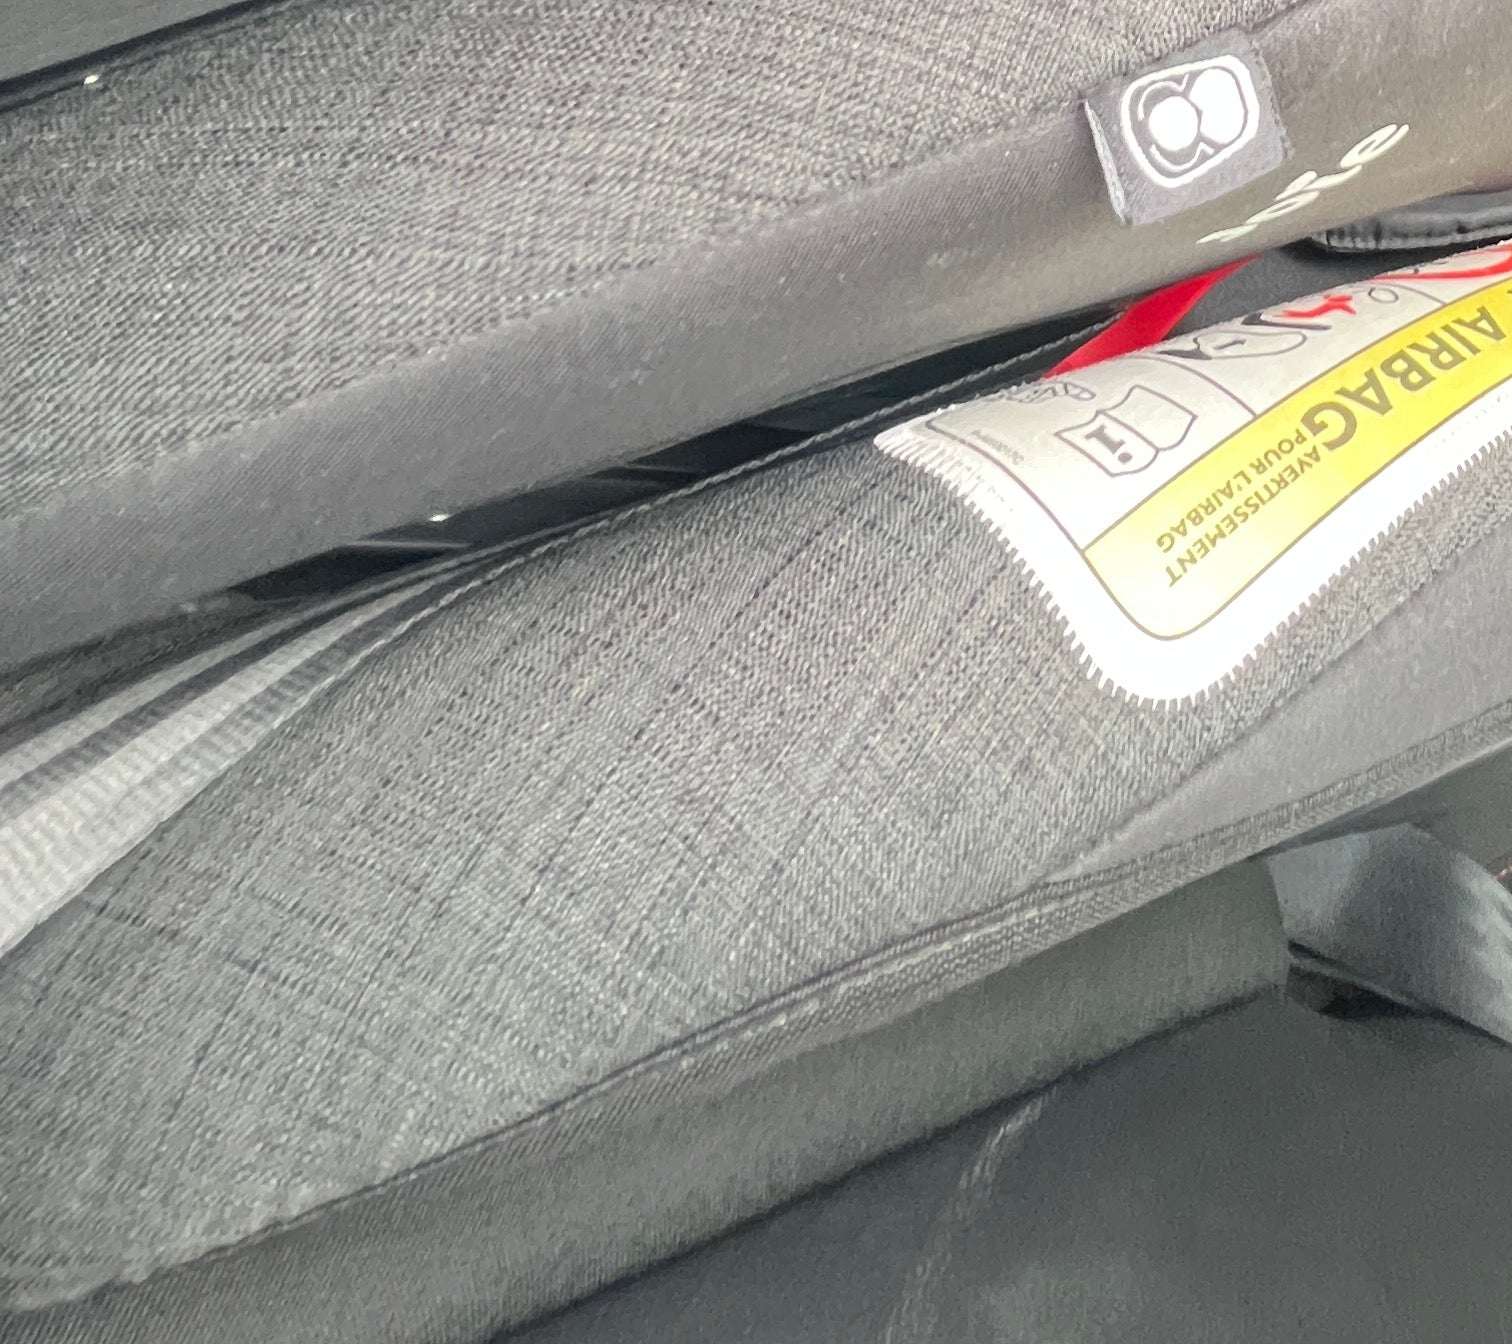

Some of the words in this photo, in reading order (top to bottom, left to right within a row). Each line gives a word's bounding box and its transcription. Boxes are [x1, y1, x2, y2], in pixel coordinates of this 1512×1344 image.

[1300, 303, 1508, 452] AIRBAG
[1155, 467, 1254, 553] L'AIRBAG
[1249, 428, 1306, 479] POUR
[1164, 444, 1321, 588] AVERTISSEMENT
